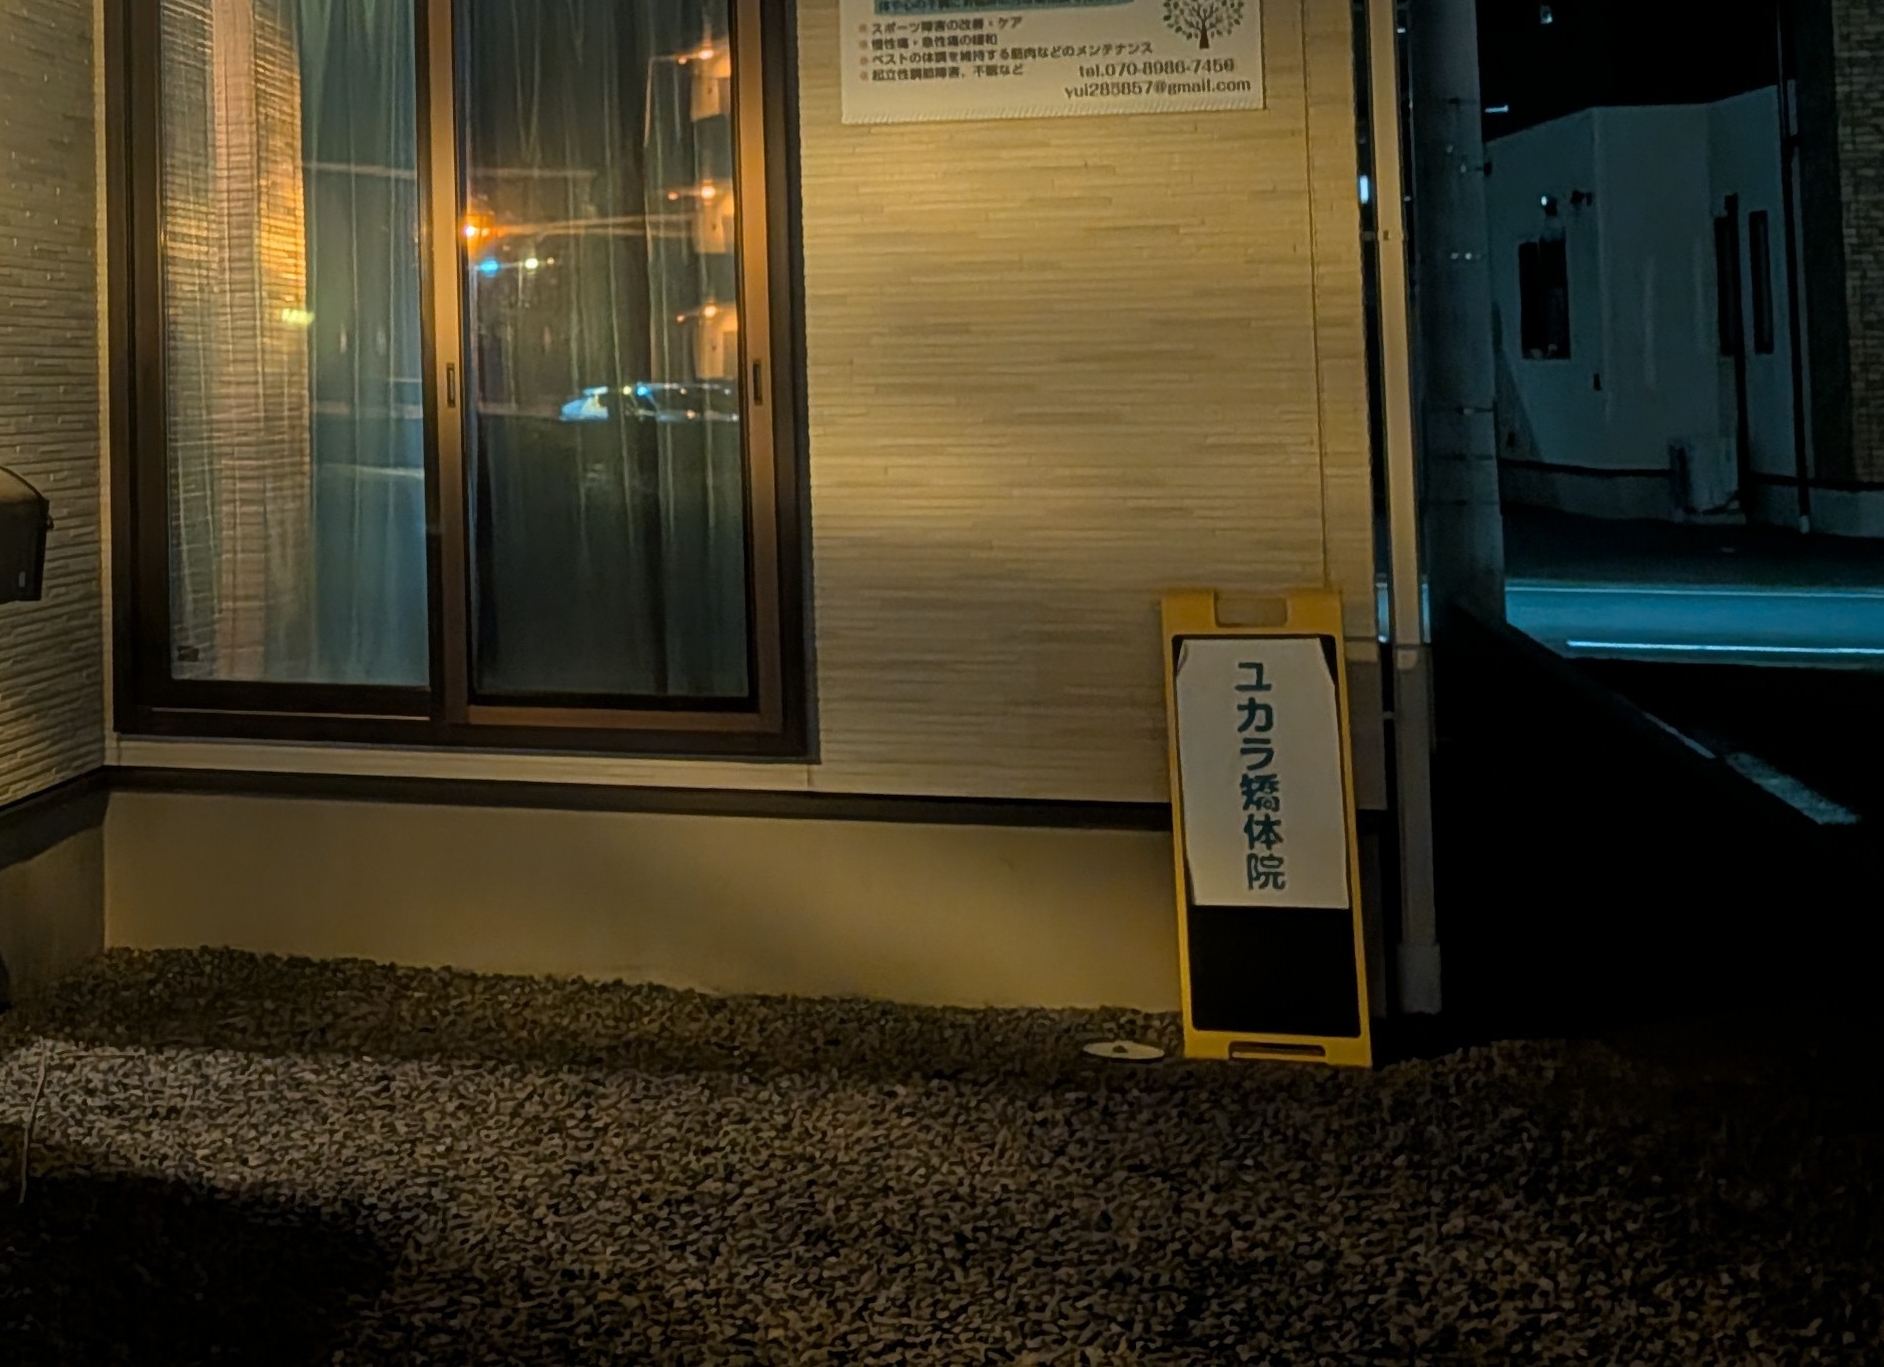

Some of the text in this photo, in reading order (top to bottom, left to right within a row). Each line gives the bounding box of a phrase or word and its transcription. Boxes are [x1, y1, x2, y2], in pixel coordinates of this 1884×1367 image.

[1234, 661, 1287, 891] ユカラ矯体院
